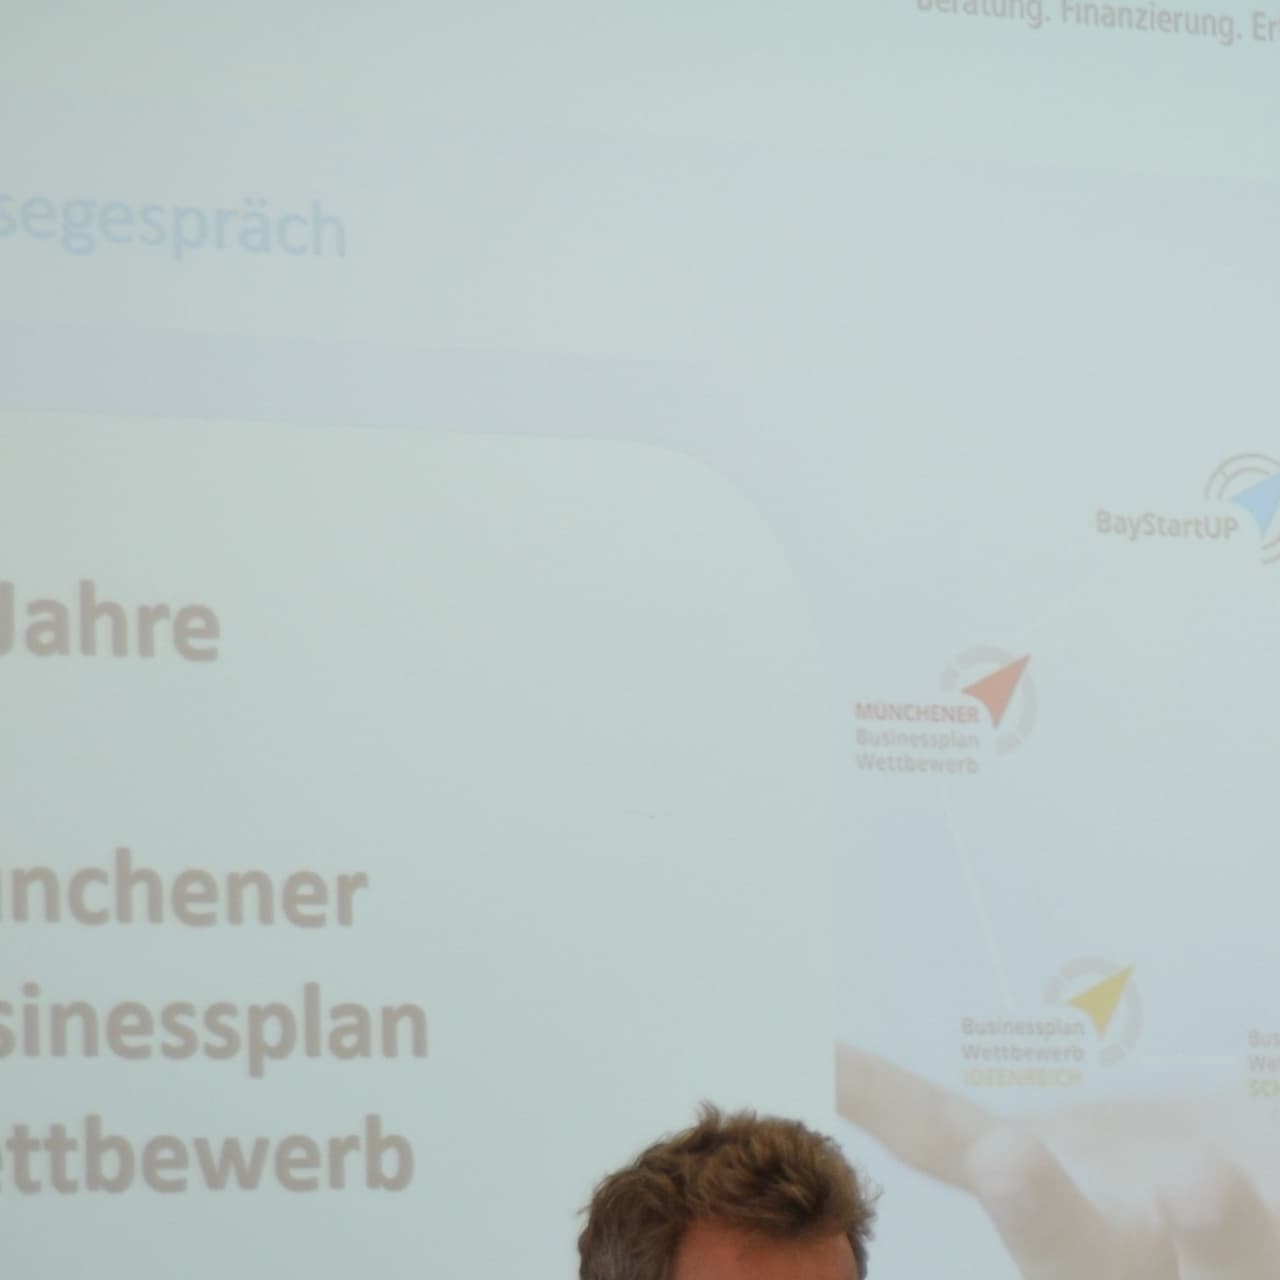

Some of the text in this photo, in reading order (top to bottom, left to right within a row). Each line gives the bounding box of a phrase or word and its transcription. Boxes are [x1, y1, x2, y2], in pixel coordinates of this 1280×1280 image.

[1061, 0, 1243, 46] Finanzierung.
[1096, 510, 1239, 541] BayStartUP
[854, 698, 980, 724] MÜNCHENER
[0, 847, 369, 929] nchener
[0, 1113, 415, 1195] ttbewerb
